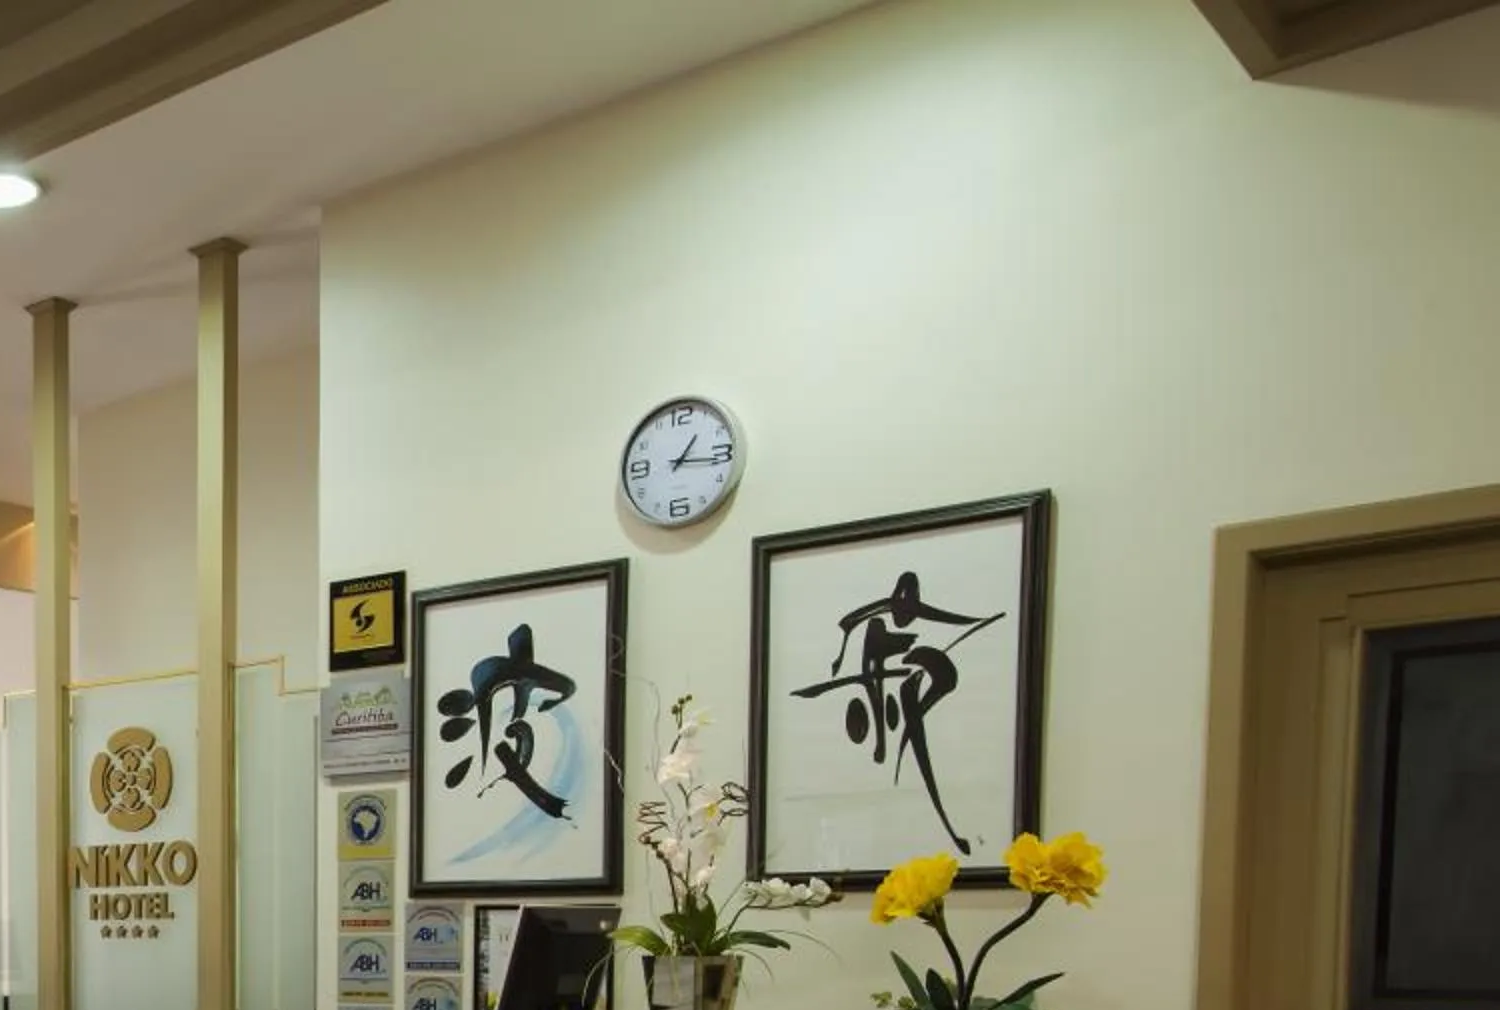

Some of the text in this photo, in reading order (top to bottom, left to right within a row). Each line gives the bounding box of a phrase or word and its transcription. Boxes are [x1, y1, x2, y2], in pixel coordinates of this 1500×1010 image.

[671, 406, 693, 427] 12
[712, 444, 733, 465] 3
[631, 460, 650, 480] 9
[669, 498, 690, 518] 6
[89, 892, 175, 921] HOTEL
